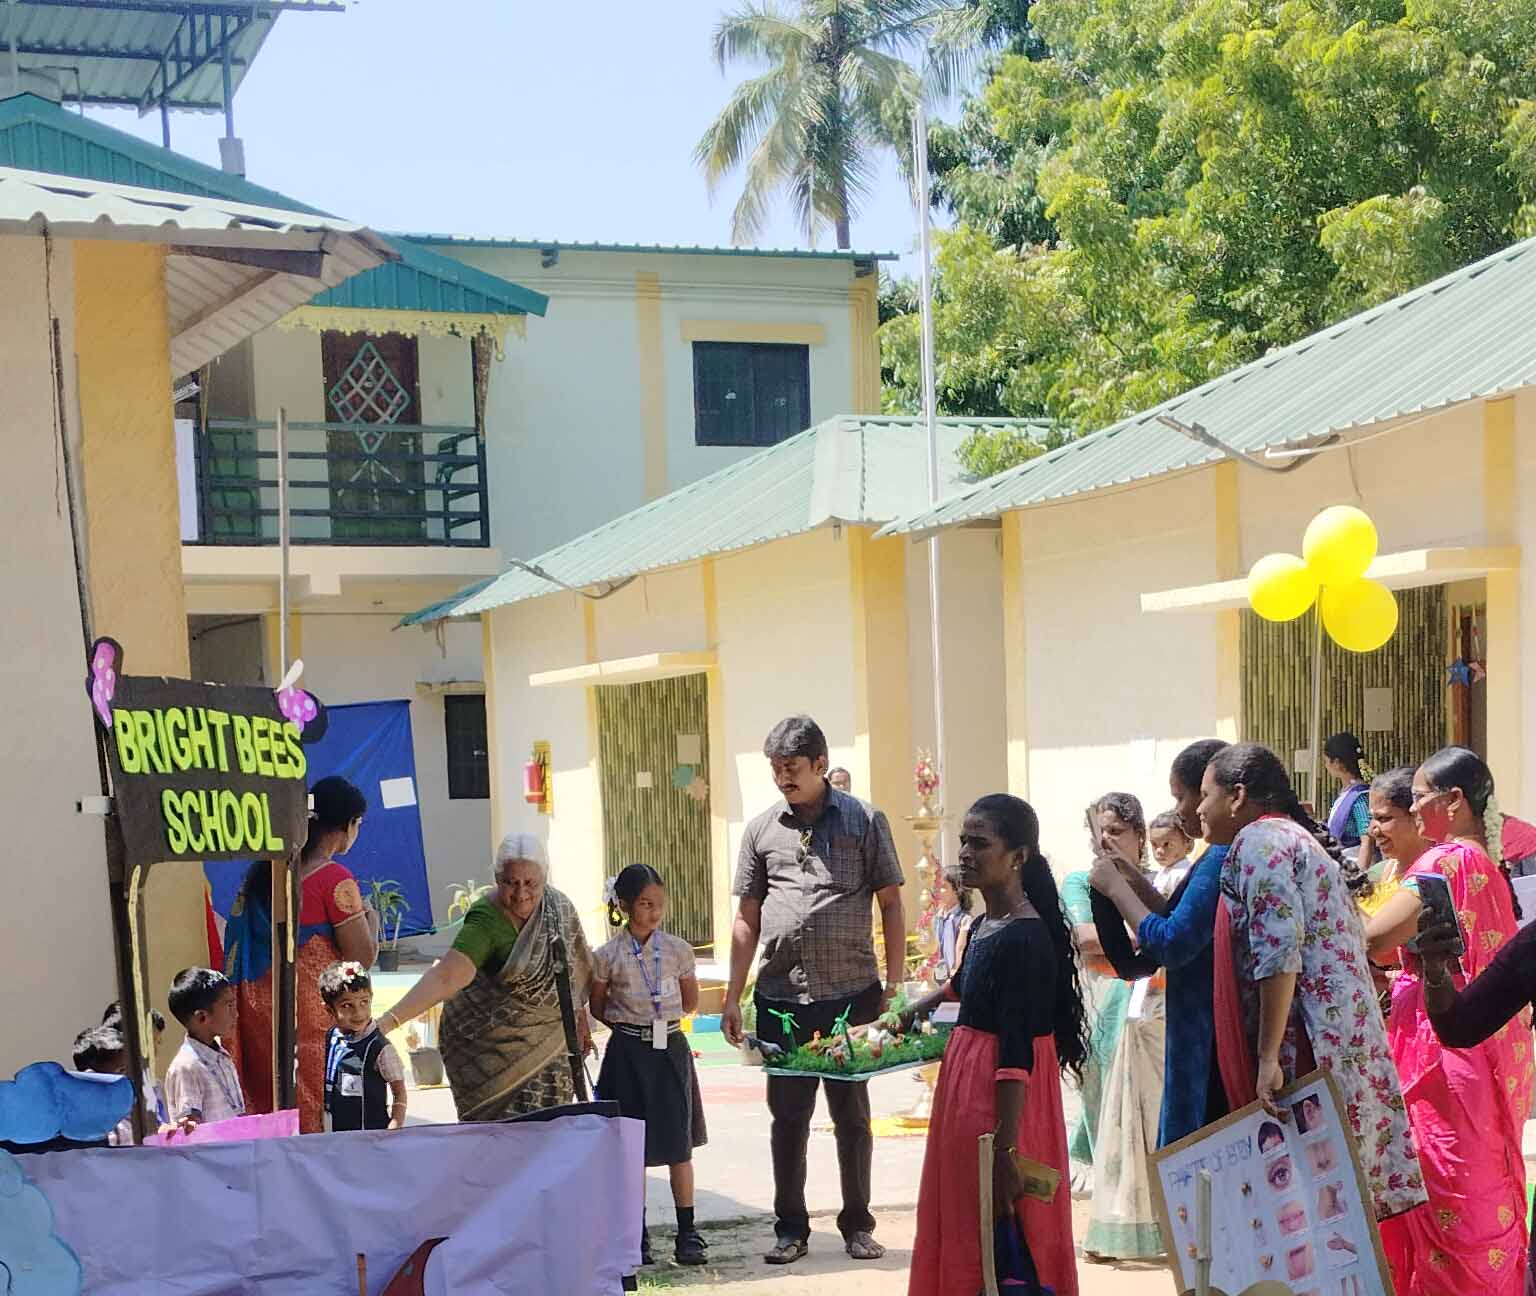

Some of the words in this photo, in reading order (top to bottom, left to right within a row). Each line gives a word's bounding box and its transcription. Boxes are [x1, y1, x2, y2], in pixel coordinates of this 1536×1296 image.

[112, 706, 229, 775] BRIGHT
[232, 715, 307, 780] BEES
[161, 788, 284, 855] SCHOOL
